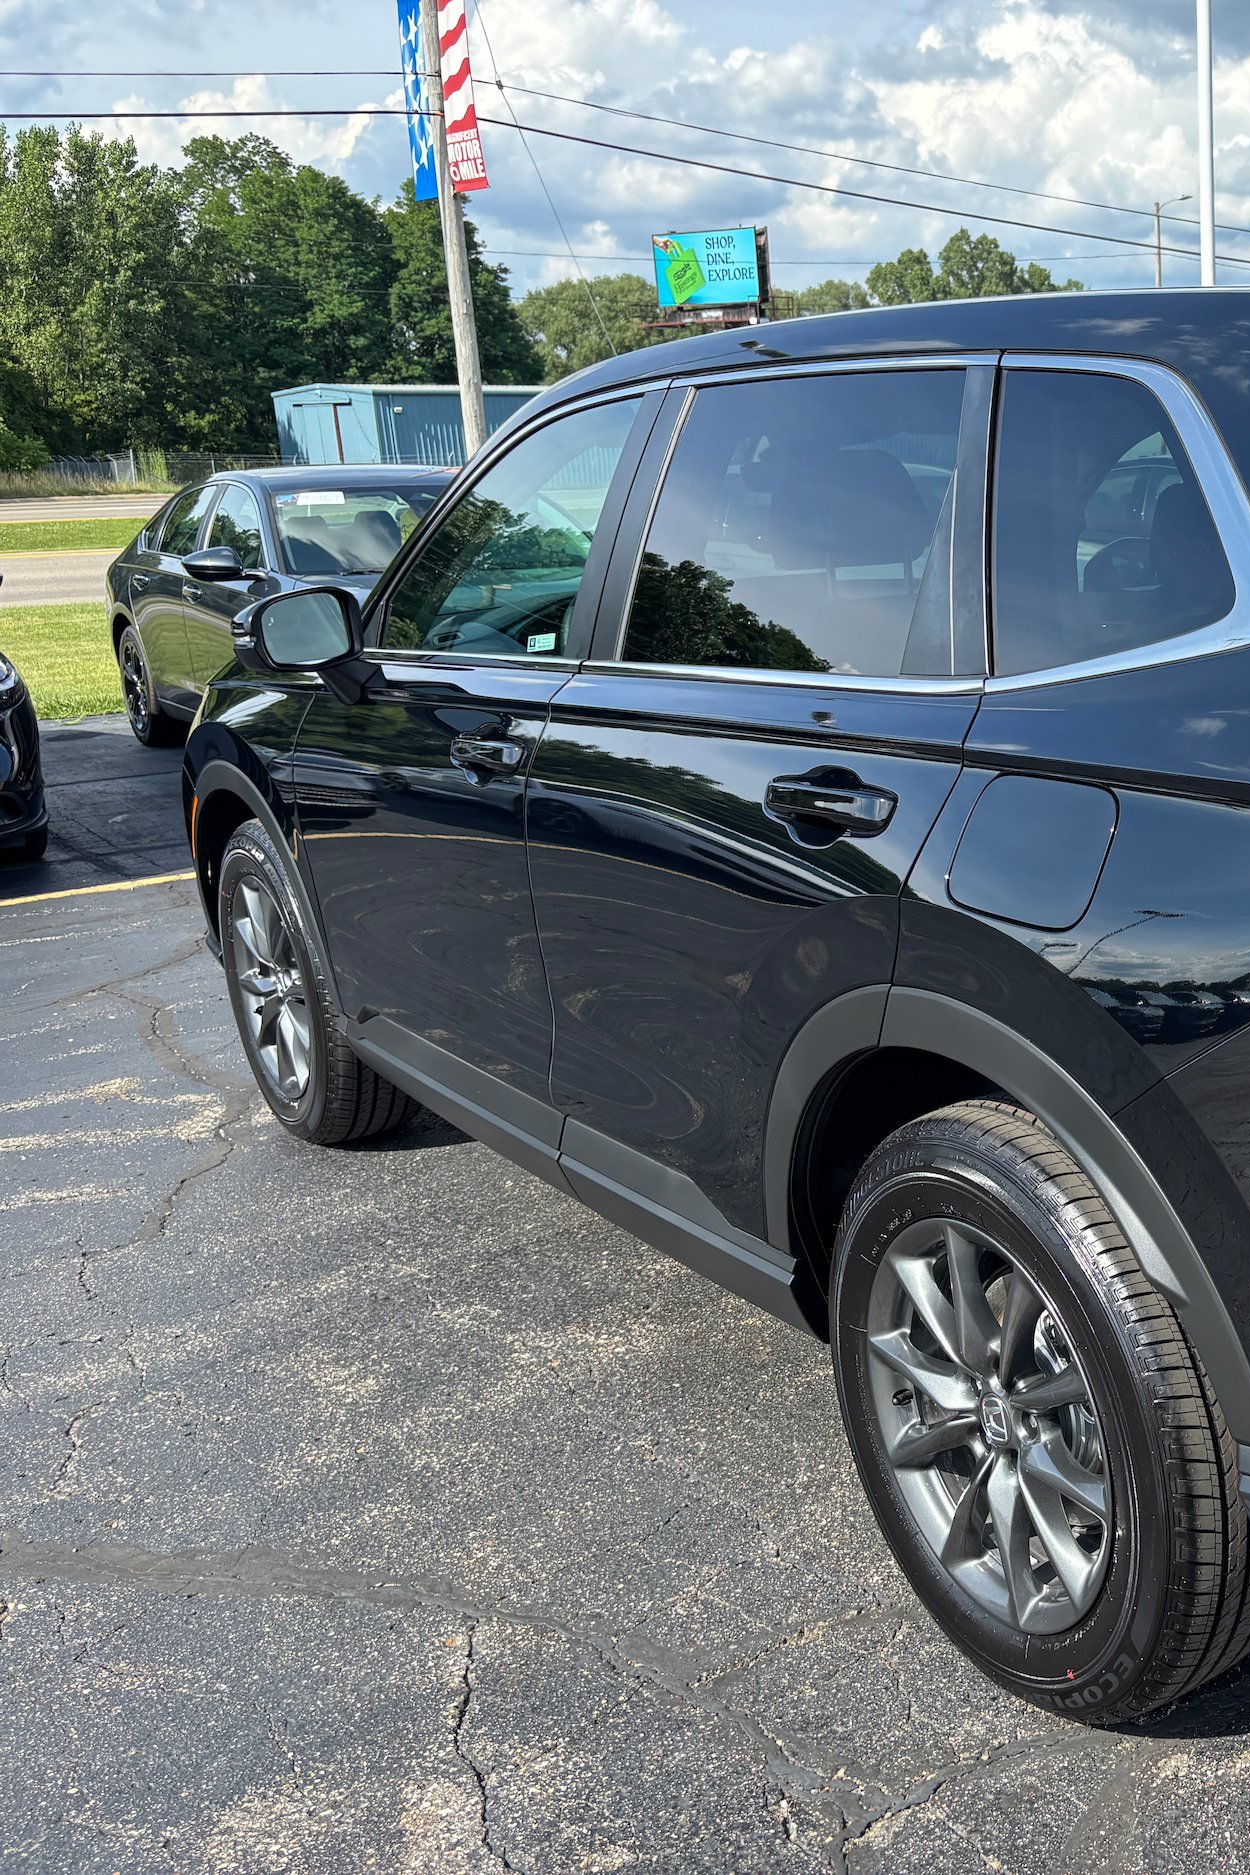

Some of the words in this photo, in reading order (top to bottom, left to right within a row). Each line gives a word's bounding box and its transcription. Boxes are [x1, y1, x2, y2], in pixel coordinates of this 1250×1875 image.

[447, 139, 482, 164] MOTOR
[705, 236, 736, 250] SHOP,
[707, 252, 734, 266] DINE,
[708, 267, 755, 282] EXPLORE
